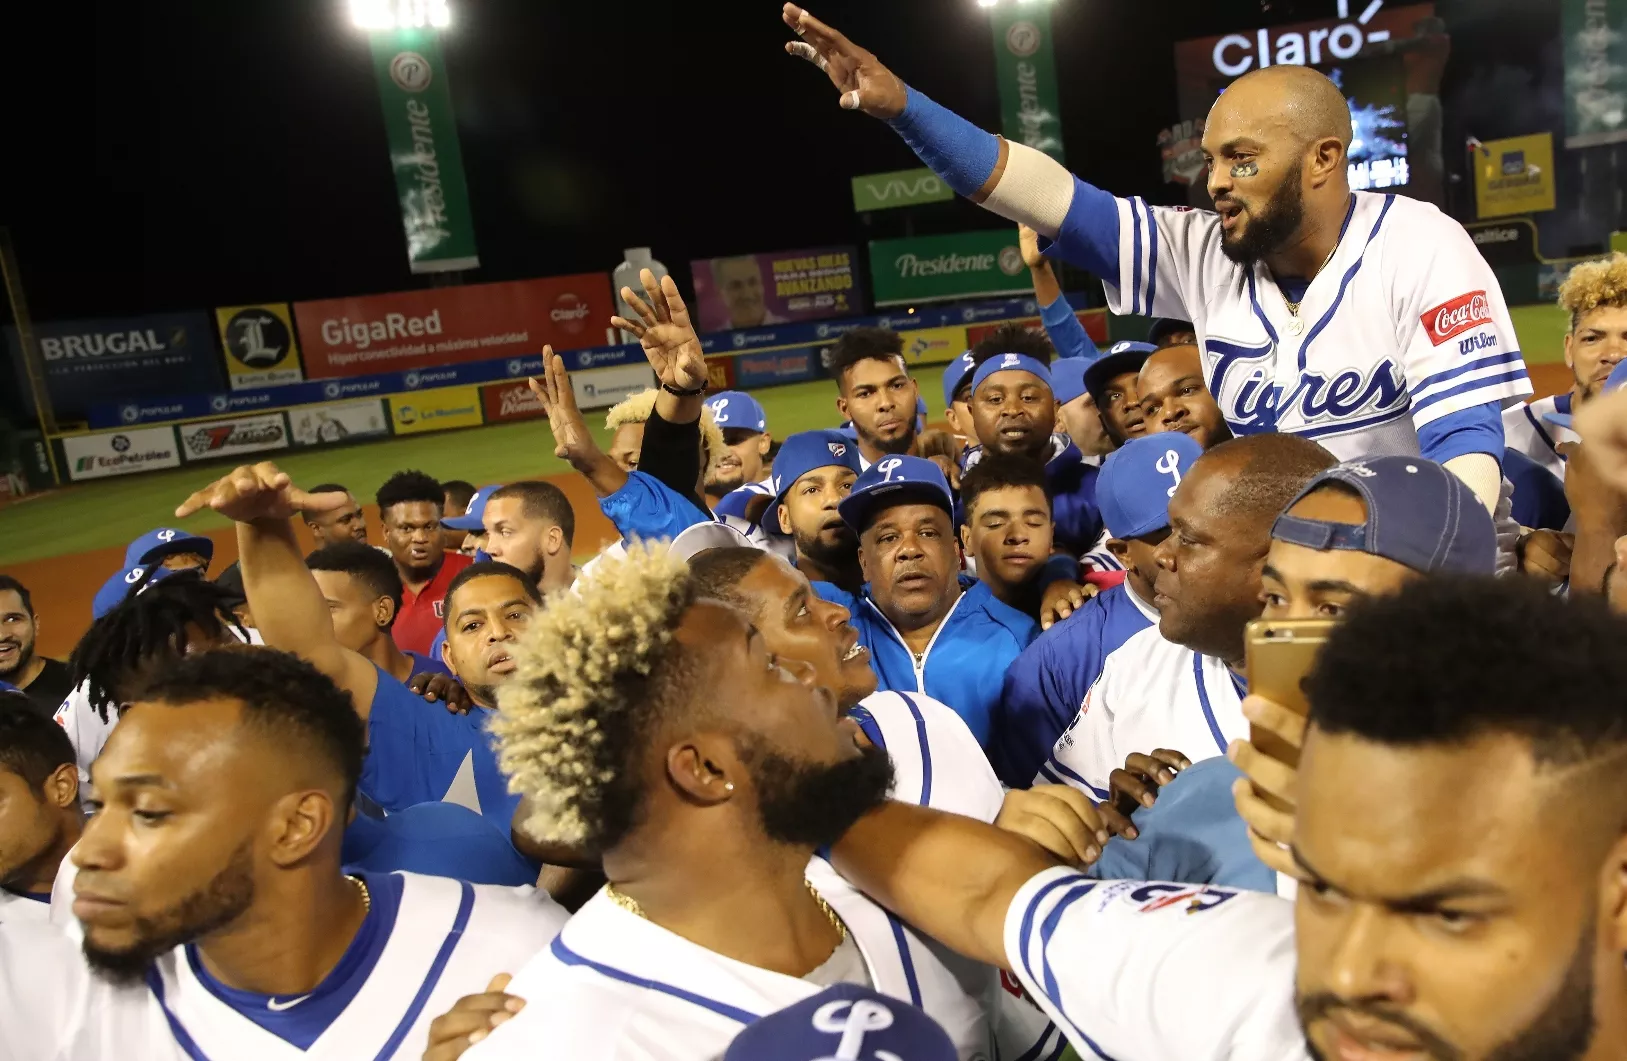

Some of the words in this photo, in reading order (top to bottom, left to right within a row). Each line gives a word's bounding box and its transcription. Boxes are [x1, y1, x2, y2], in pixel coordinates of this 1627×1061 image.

[1213, 22, 1366, 76] Claro
[895, 253, 995, 278] Presidente
[776, 274, 853, 297] AVANZANDO
[551, 305, 587, 321] Claro
[321, 308, 443, 349] GigaRed
[40, 328, 166, 361] BRUGAL
[592, 350, 626, 361] POPULAR
[341, 381, 380, 393] POPULAR
[420, 371, 457, 382] POPULAR
[1205, 335, 1410, 430] Tigres
[140, 404, 183, 417] POPULAR
[228, 394, 270, 406] POPULAR
[711, 398, 729, 423] L
